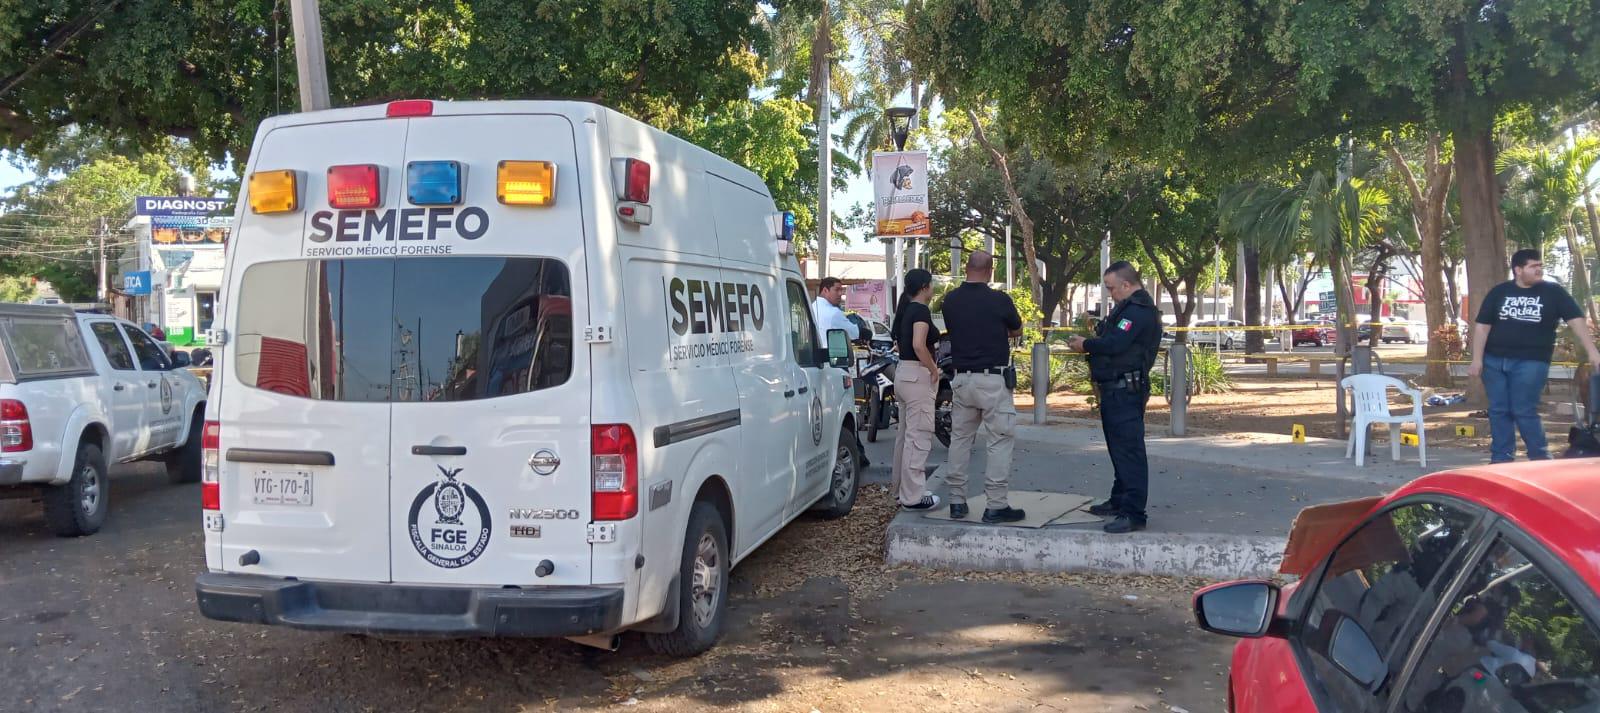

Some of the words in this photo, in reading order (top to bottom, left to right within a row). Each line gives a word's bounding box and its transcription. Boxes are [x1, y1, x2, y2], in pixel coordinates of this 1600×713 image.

[145, 199, 228, 211] DIAGNOST
[308, 206, 490, 243] SEMEFO
[306, 247, 353, 257] SERVICIO
[356, 243, 398, 256] MÉDICO
[401, 245, 453, 255] FORENSE
[669, 277, 764, 336] SEMEFO
[673, 343, 705, 360] SERVICIO
[706, 338, 729, 357] MÉDICO
[730, 340, 754, 354] FORENSE
[254, 478, 310, 495] VTG-170-A
[509, 508, 580, 520] NV2500
[431, 528, 467, 544] FGE
[514, 526, 536, 536] HD
[427, 553, 460, 567] GENERAL
[460, 555, 475, 566] DEL
[473, 527, 489, 555] ESTADO
[430, 543, 467, 552] SINALOA
